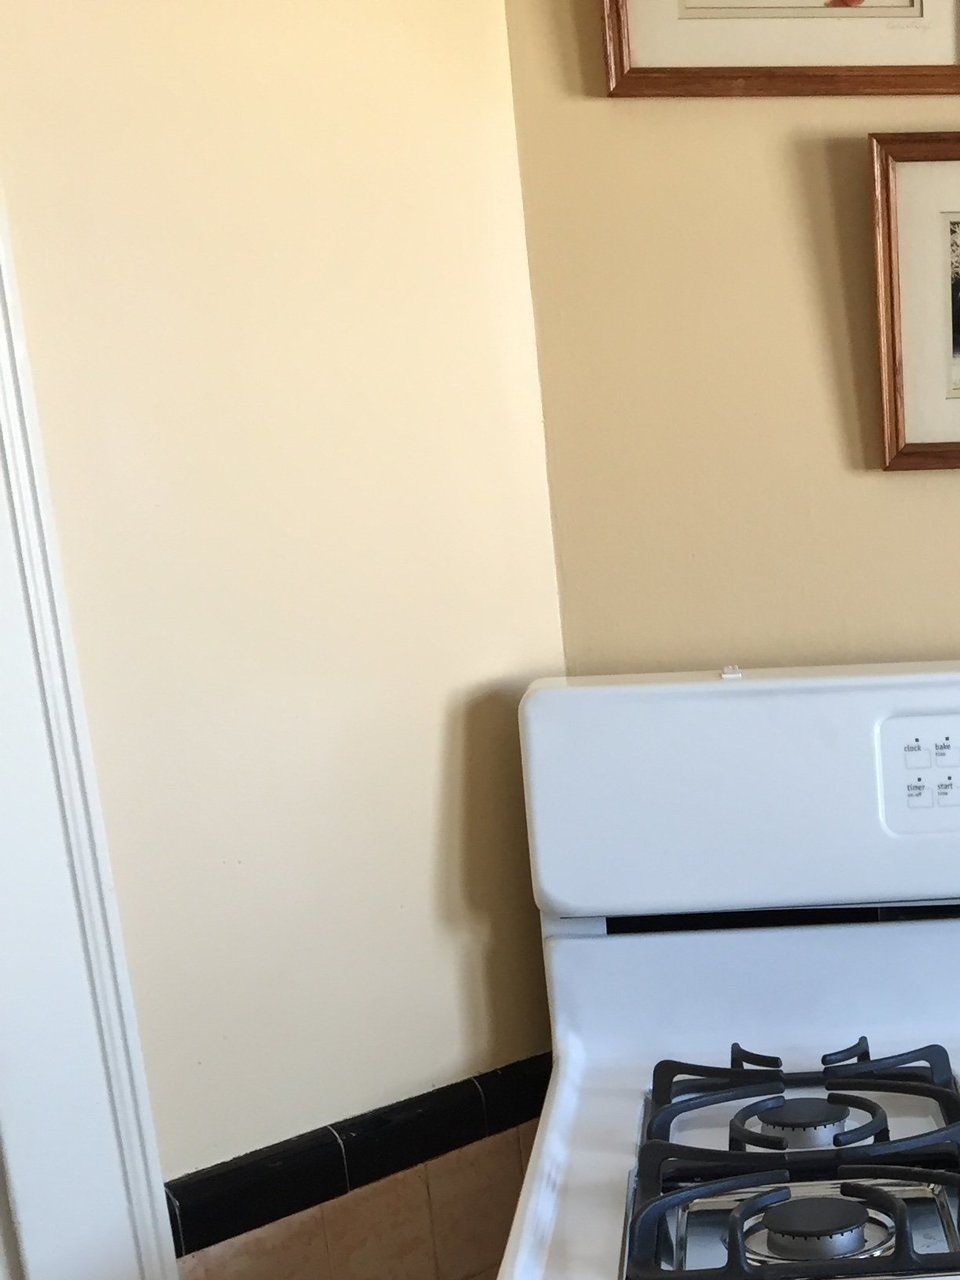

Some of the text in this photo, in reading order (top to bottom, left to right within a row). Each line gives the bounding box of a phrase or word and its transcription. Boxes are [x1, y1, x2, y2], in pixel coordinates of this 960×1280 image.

[904, 744, 922, 752] clock
[934, 743, 951, 751] bake
[937, 782, 953, 790] start
